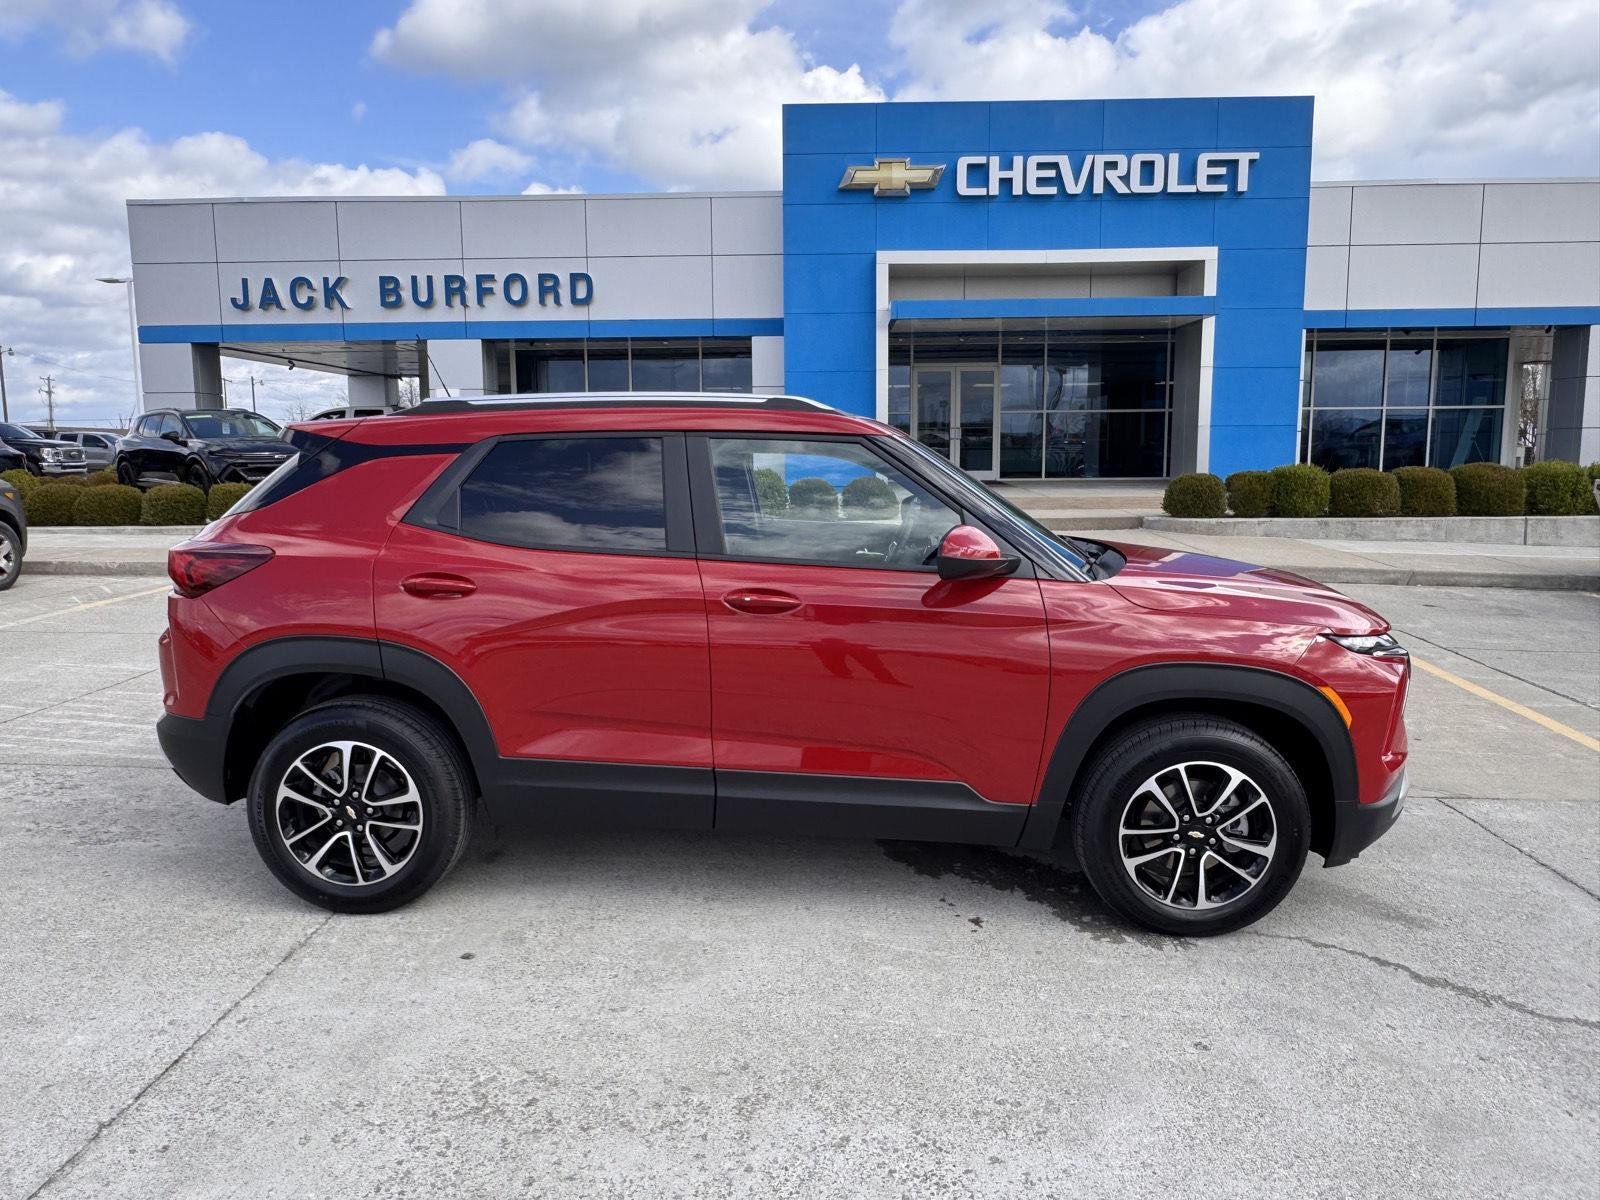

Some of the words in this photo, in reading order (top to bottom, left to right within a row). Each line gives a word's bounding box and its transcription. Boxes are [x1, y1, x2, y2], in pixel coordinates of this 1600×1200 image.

[956, 152, 1260, 196] CHEVROLET
[230, 276, 351, 310] JACK
[378, 272, 594, 308] BURFORD
